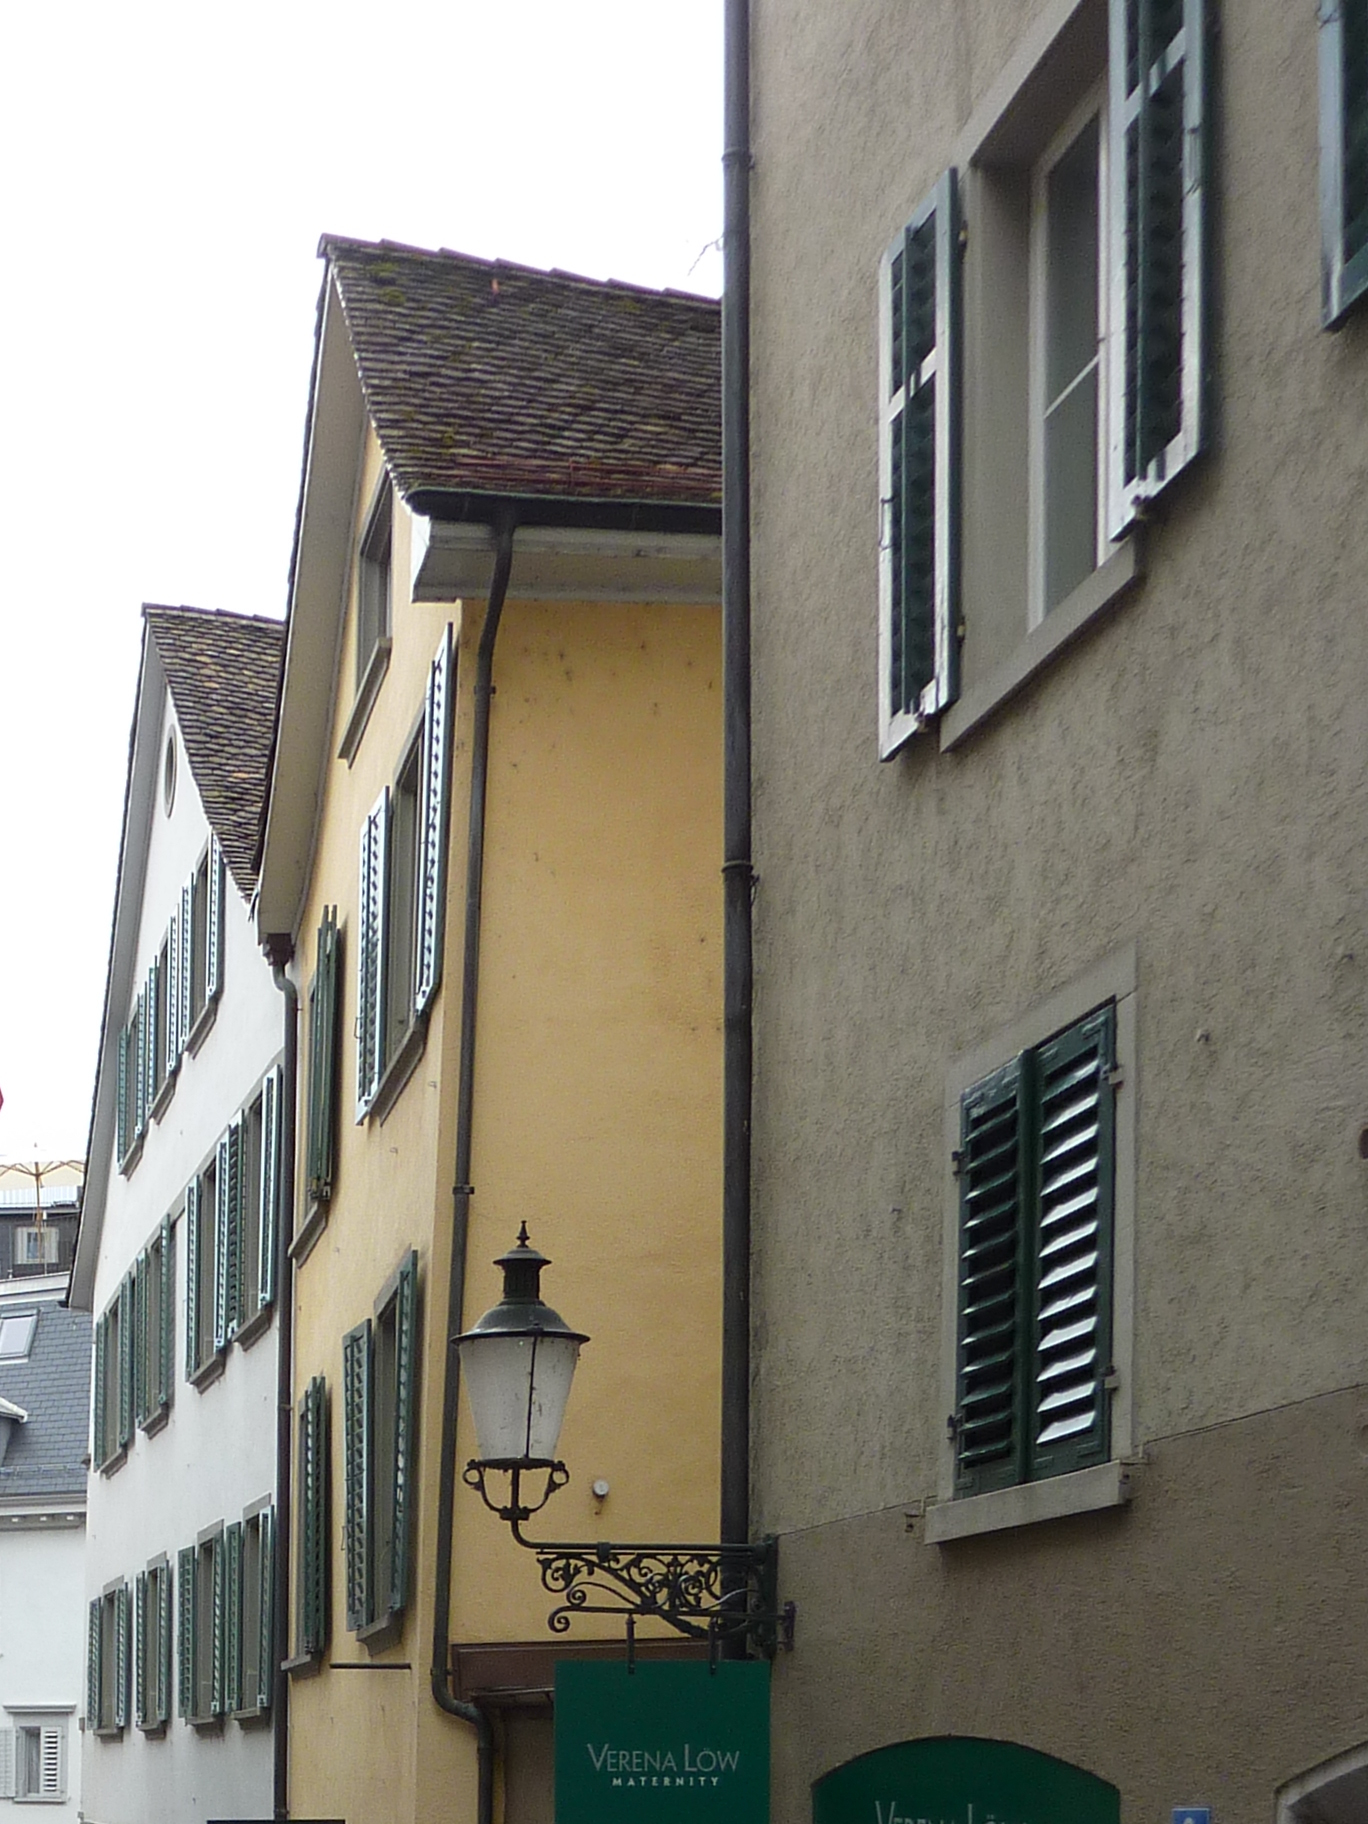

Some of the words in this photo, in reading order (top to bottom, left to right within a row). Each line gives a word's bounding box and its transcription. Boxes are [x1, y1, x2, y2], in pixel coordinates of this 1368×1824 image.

[587, 1743, 677, 1772] VERENA
[684, 1743, 740, 1772] LÖW
[611, 1777, 719, 1787] MATERNITY
